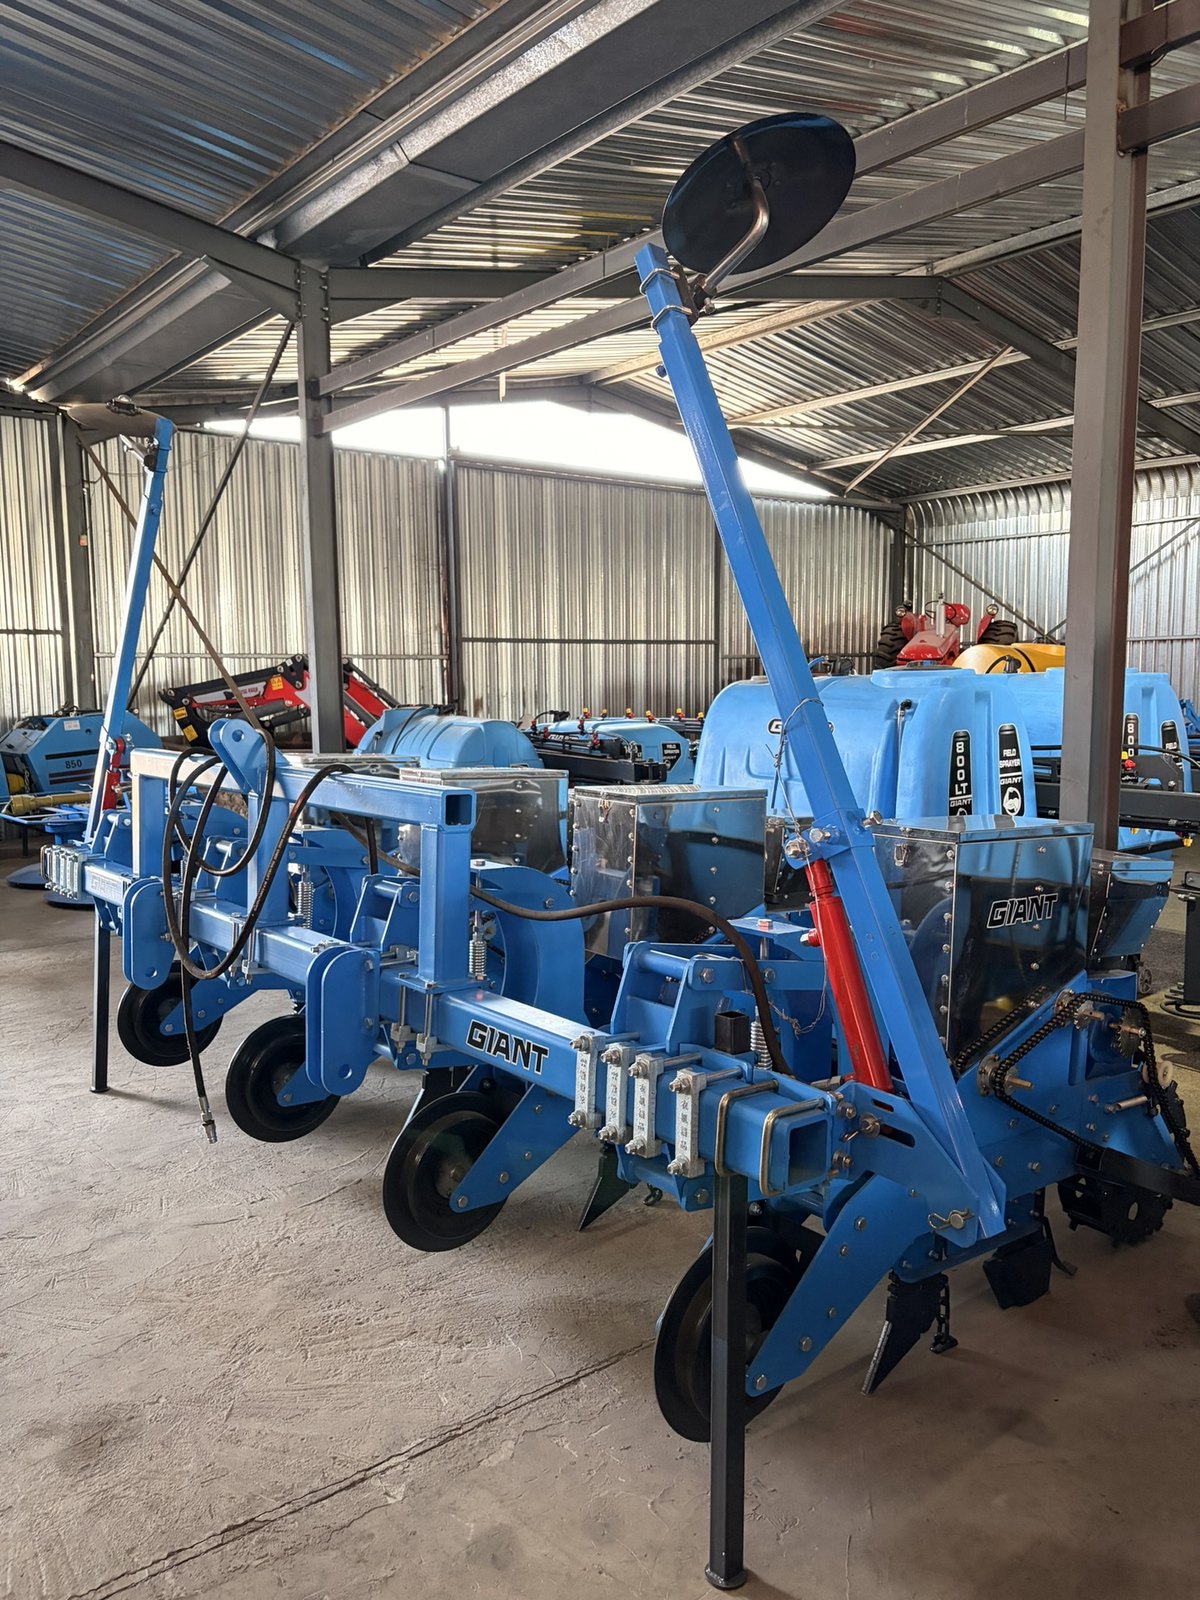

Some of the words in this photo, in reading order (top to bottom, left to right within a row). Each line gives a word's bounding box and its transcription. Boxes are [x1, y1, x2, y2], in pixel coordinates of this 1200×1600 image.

[1003, 748, 1017, 757] FIELD
[65, 759, 83, 769] 850
[956, 741, 965, 781] 800
[999, 758, 1021, 769] SPRAYER
[1000, 776, 1022, 785] GIANT
[955, 782, 968, 795] LT
[950, 799, 972, 808] GIANT
[986, 893, 1058, 929] GIANT
[466, 1019, 549, 1075] GIANT
